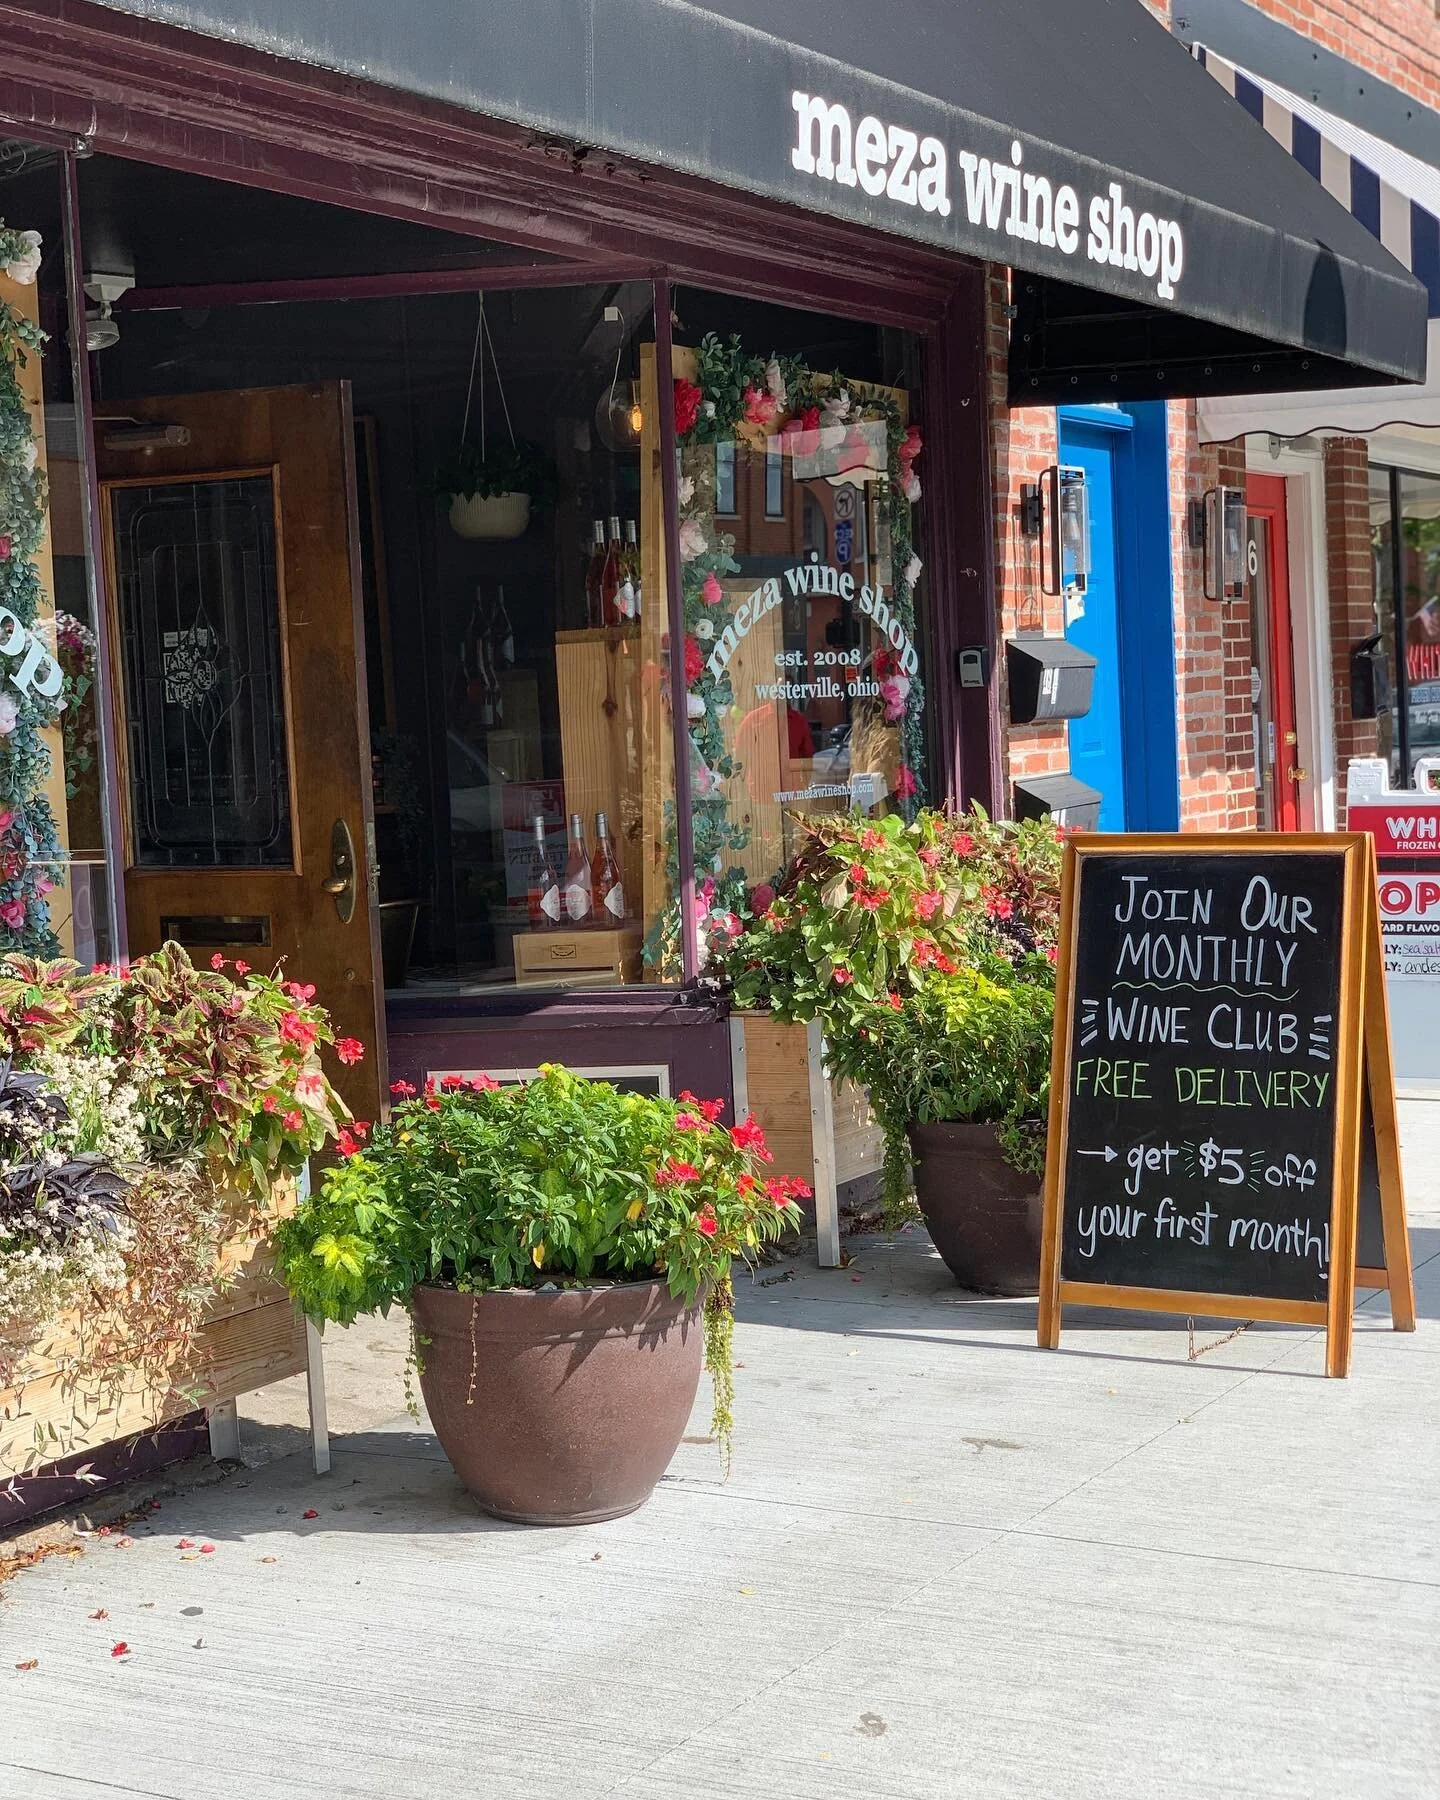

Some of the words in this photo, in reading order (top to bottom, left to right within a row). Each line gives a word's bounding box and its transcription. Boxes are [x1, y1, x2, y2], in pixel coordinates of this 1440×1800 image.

[791, 91, 951, 217] meza
[959, 140, 1080, 255] wine
[1087, 182, 1184, 300] shop
[1248, 539, 1257, 576] 6
[706, 577, 783, 684] meza
[784, 552, 855, 601] wine
[859, 583, 919, 675] shop
[774, 650, 808, 667] est.
[813, 648, 861, 666] 2008
[755, 676, 844, 701] westerville,
[847, 676, 880, 697] ohio
[773, 782, 874, 803] www.mezawineshop.com
[1386, 817, 1440, 839] WH
[1396, 841, 1436, 850] FROZEN
[1115, 876, 1212, 924] JOIN
[1240, 875, 1317, 933] OUR
[1380, 923, 1404, 932] ARD
[1116, 933, 1298, 987] MONTHLY
[1107, 997, 1191, 1043] WINE
[1207, 1003, 1298, 1054] CLUB
[1075, 1057, 1153, 1099] FREE
[1174, 1066, 1329, 1109] DELIVERY
[1124, 1141, 1179, 1196] get
[1199, 1136, 1245, 1185] $5
[1264, 1153, 1317, 1192] off
[1078, 1203, 1147, 1258] your
[1153, 1197, 1219, 1246] first
[1228, 1217, 1330, 1280] month!
